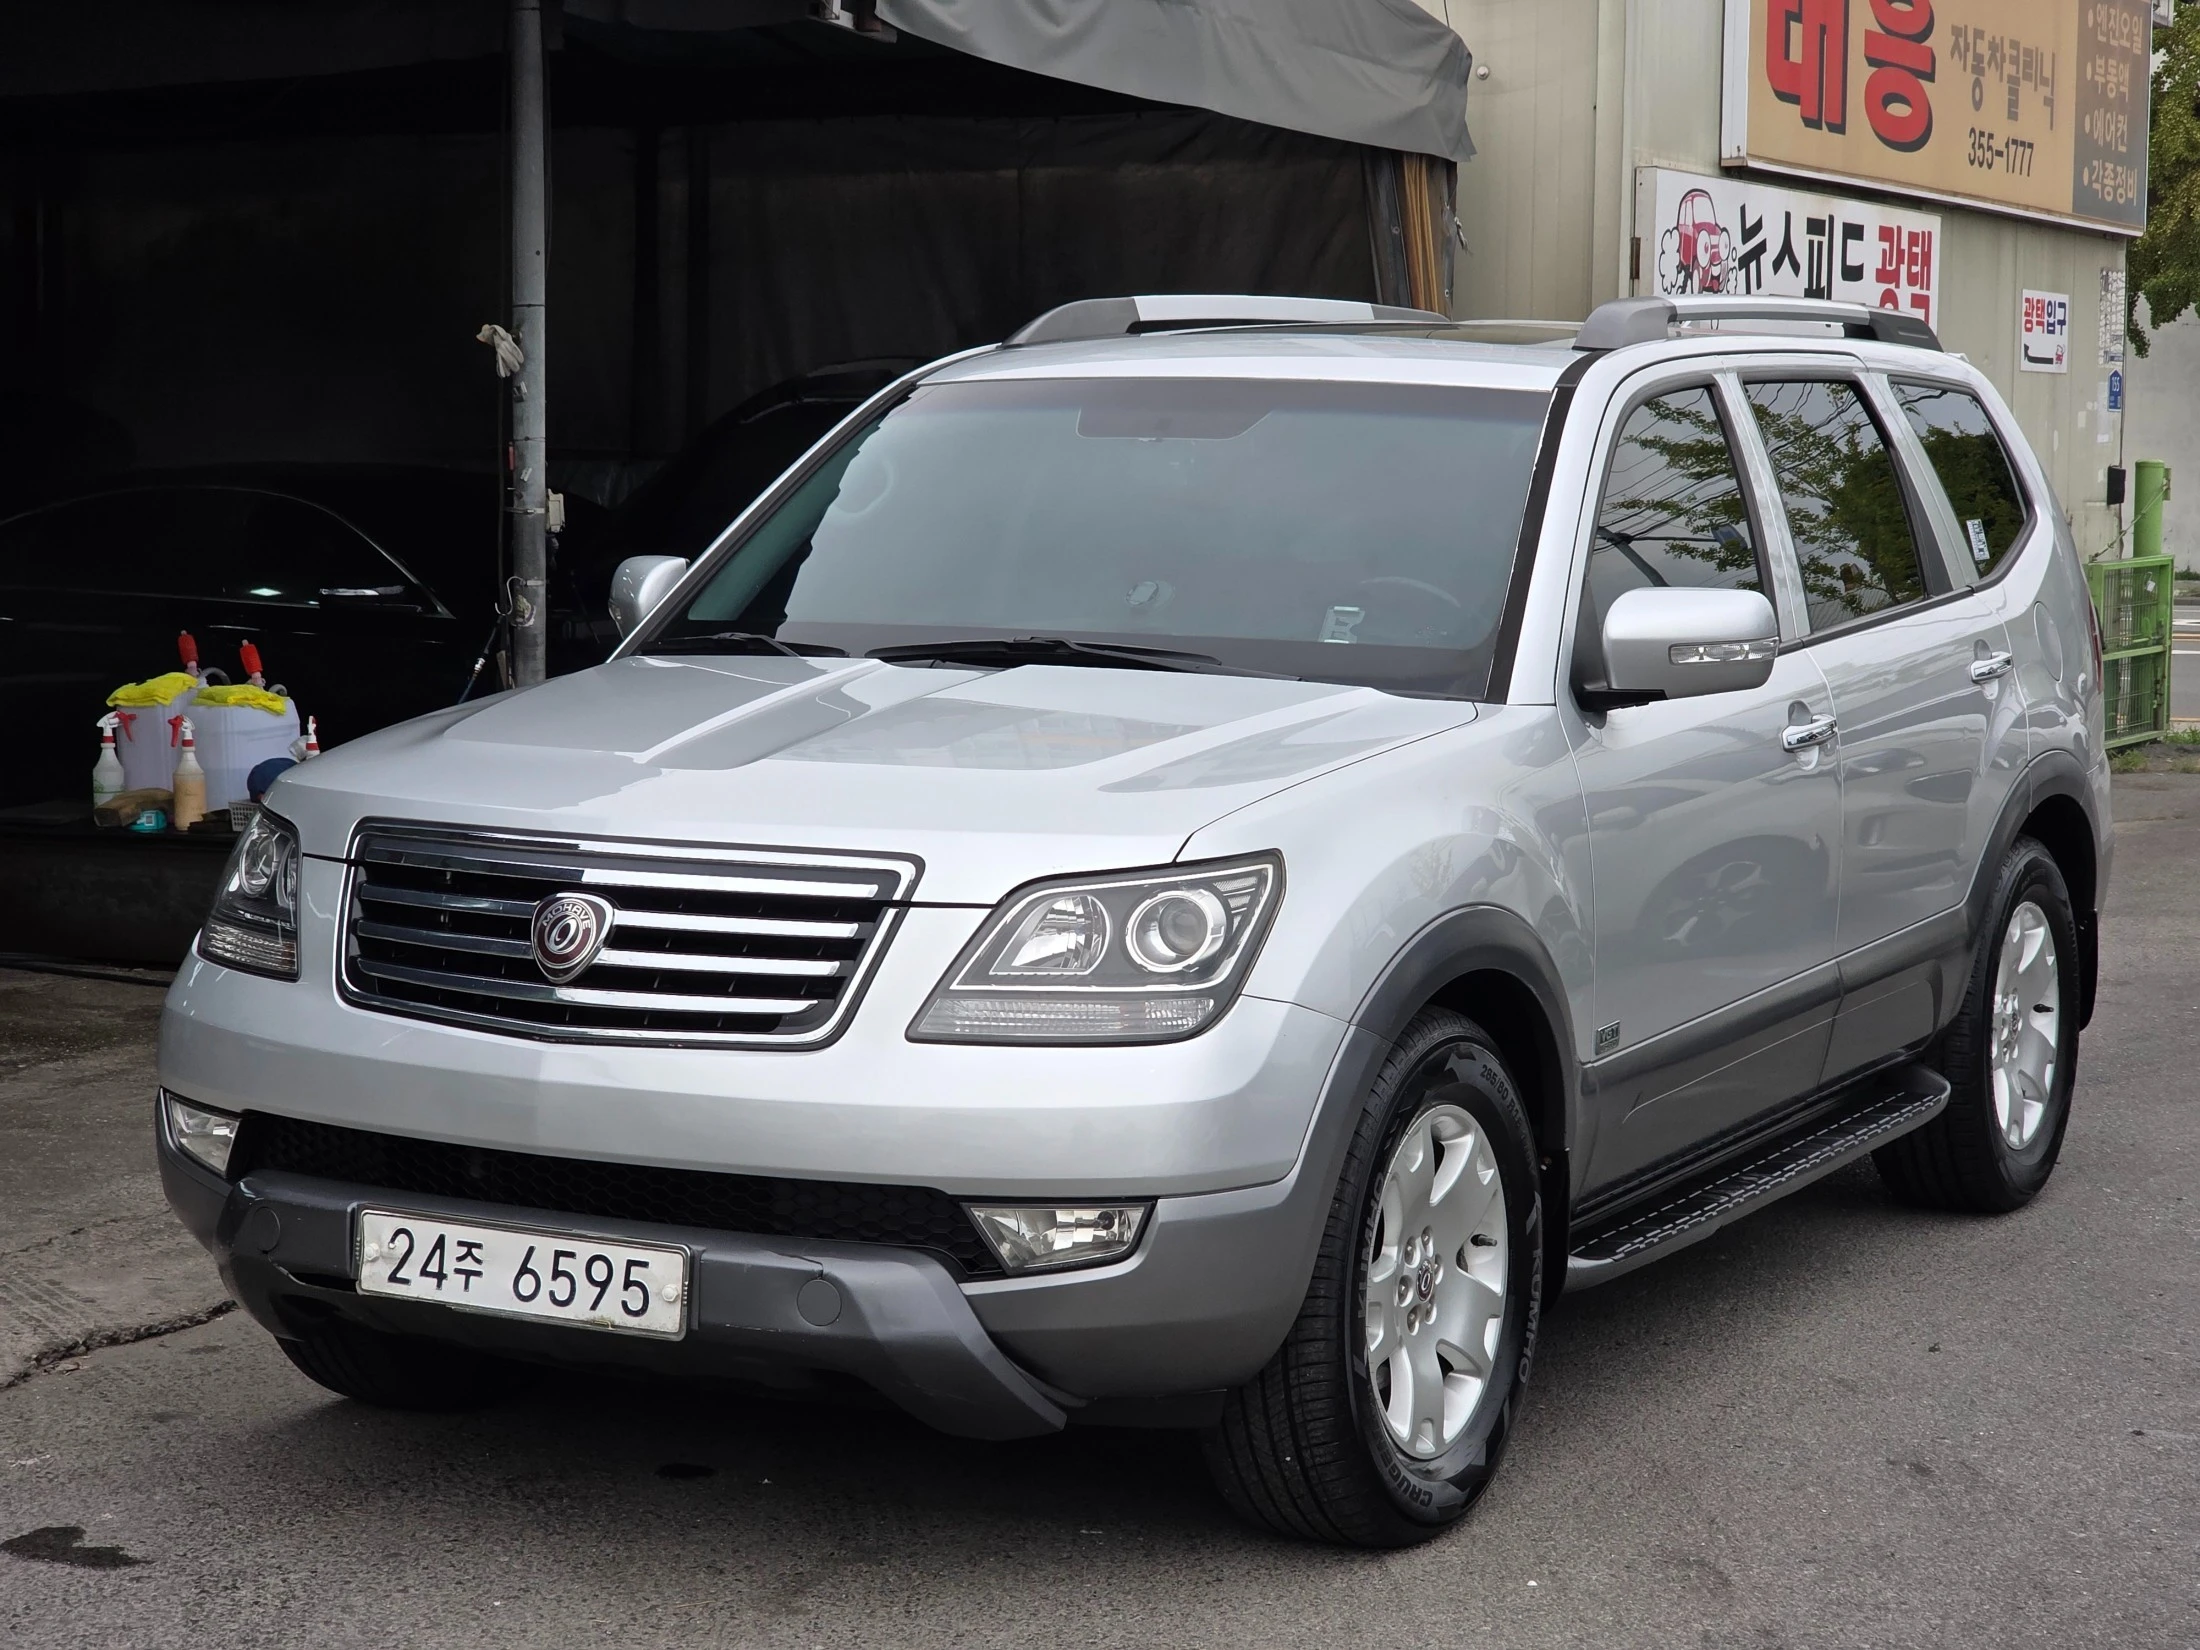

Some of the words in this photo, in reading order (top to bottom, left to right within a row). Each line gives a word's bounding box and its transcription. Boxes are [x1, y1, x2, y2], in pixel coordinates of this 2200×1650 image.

[2096, 3, 2143, 55] 엔진오일
[1950, 24, 2055, 131] 자동차클리닉
[2094, 54, 2130, 102] 부동액
[1968, 127, 2035, 177] 355-1777
[2092, 108, 2128, 153] 에어컨
[2091, 159, 2138, 206] 각종정비
[542, 903, 591, 930] MOHAVE
[387, 1227, 484, 1292] 24주
[512, 1245, 650, 1318] 6595
[1518, 1249, 1543, 1384] KUMHO
